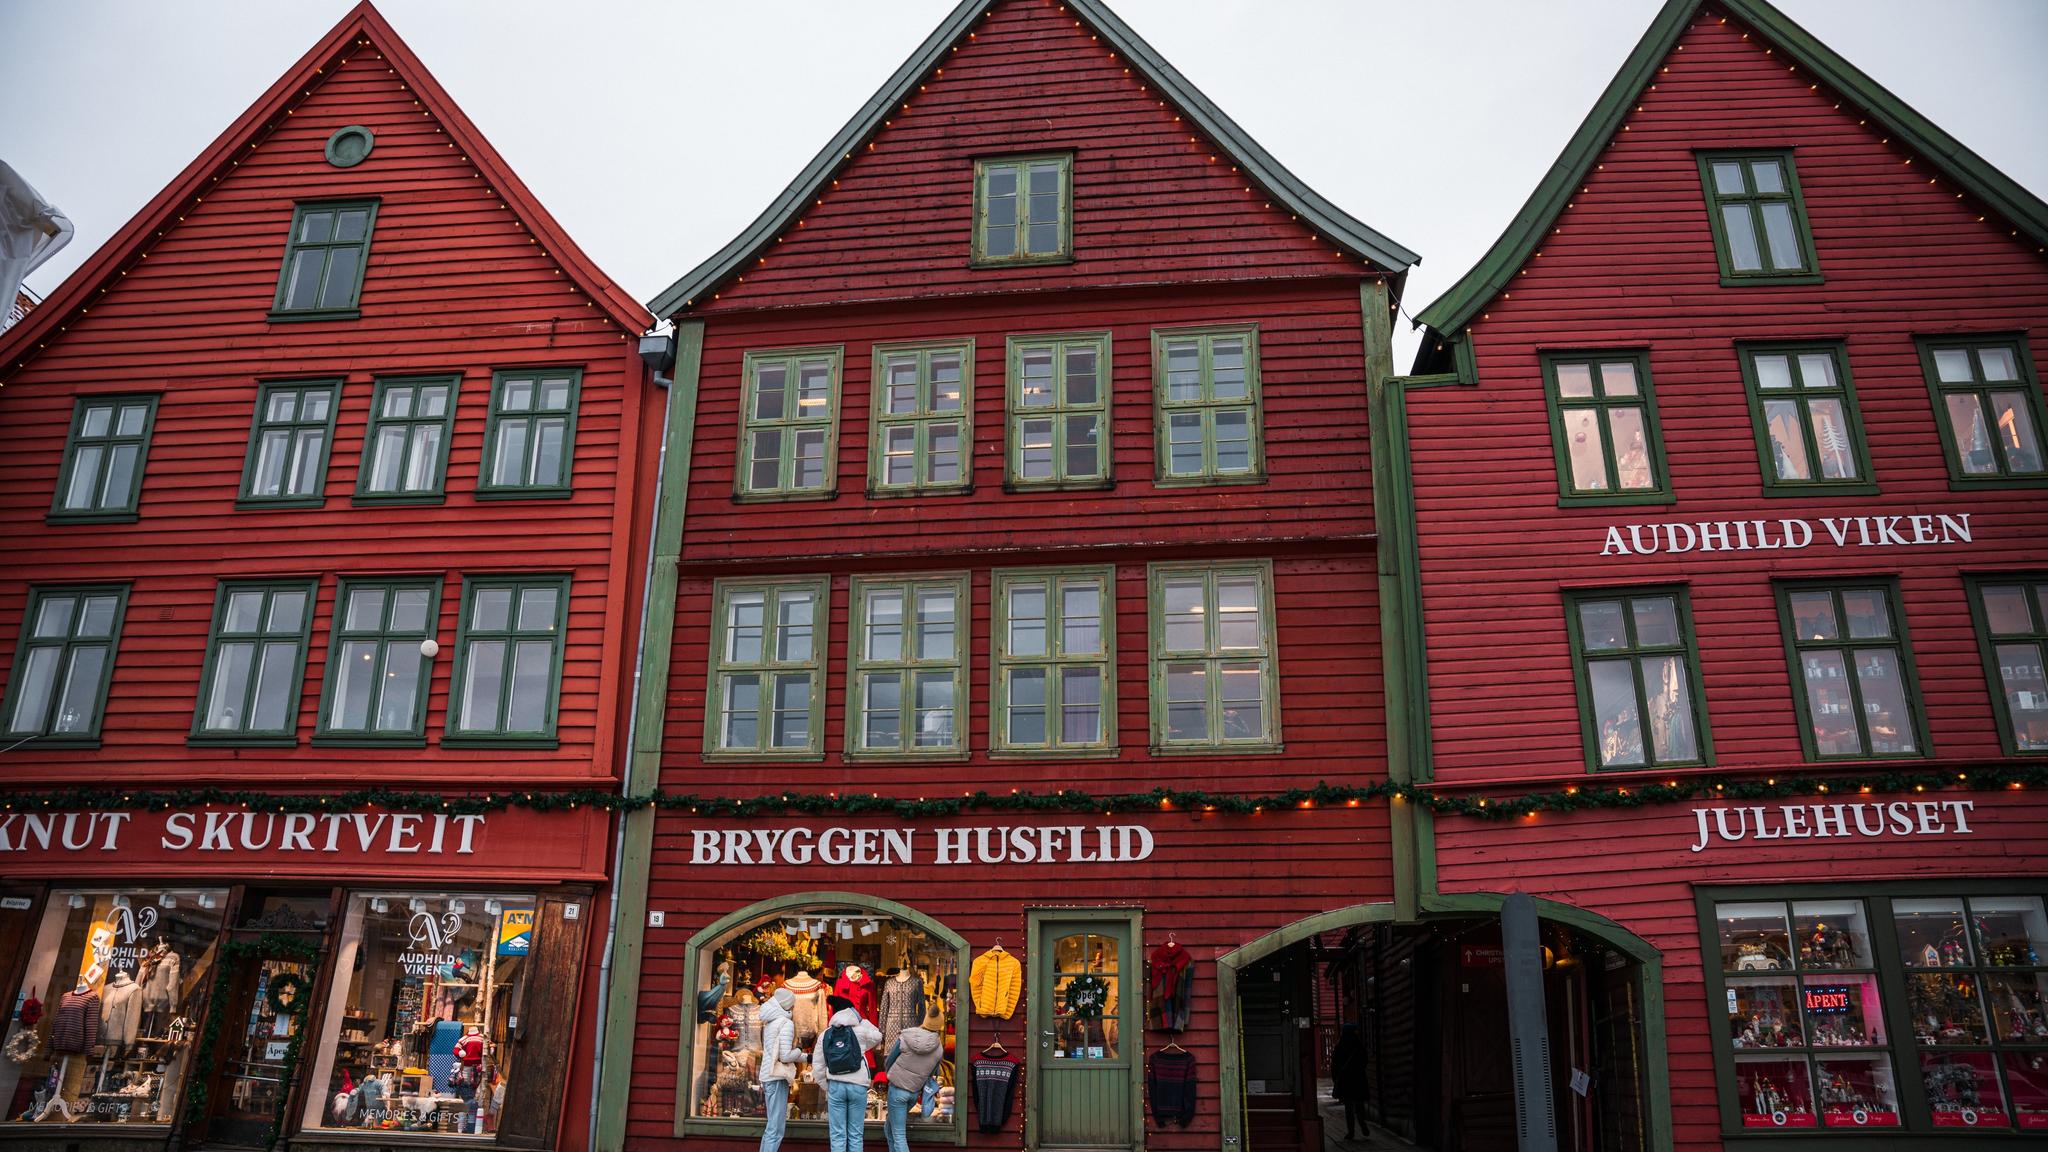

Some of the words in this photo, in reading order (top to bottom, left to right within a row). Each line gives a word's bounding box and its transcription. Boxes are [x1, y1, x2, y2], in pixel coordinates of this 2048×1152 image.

[1599, 518, 1813, 556] AUDHILD
[1819, 513, 1973, 547] VIKEN
[0, 812, 131, 851] KNUT
[160, 812, 486, 853] SKURTVEIT
[1690, 800, 1974, 852] JULEHUSET
[689, 827, 916, 865] BRYGGEN
[934, 825, 1155, 864] HUSFLID
[93, 946, 149, 958] AUDHILD
[397, 953, 455, 964] AUDHILD
[98, 958, 135, 969] VKEN
[404, 964, 442, 975] VIKEN
[1806, 992, 1847, 1009] ÅPENT
[28, 1102, 86, 1113] MEORIES
[360, 1108, 417, 1120] MEMORIES
[429, 1111, 460, 1124] GIFTS
